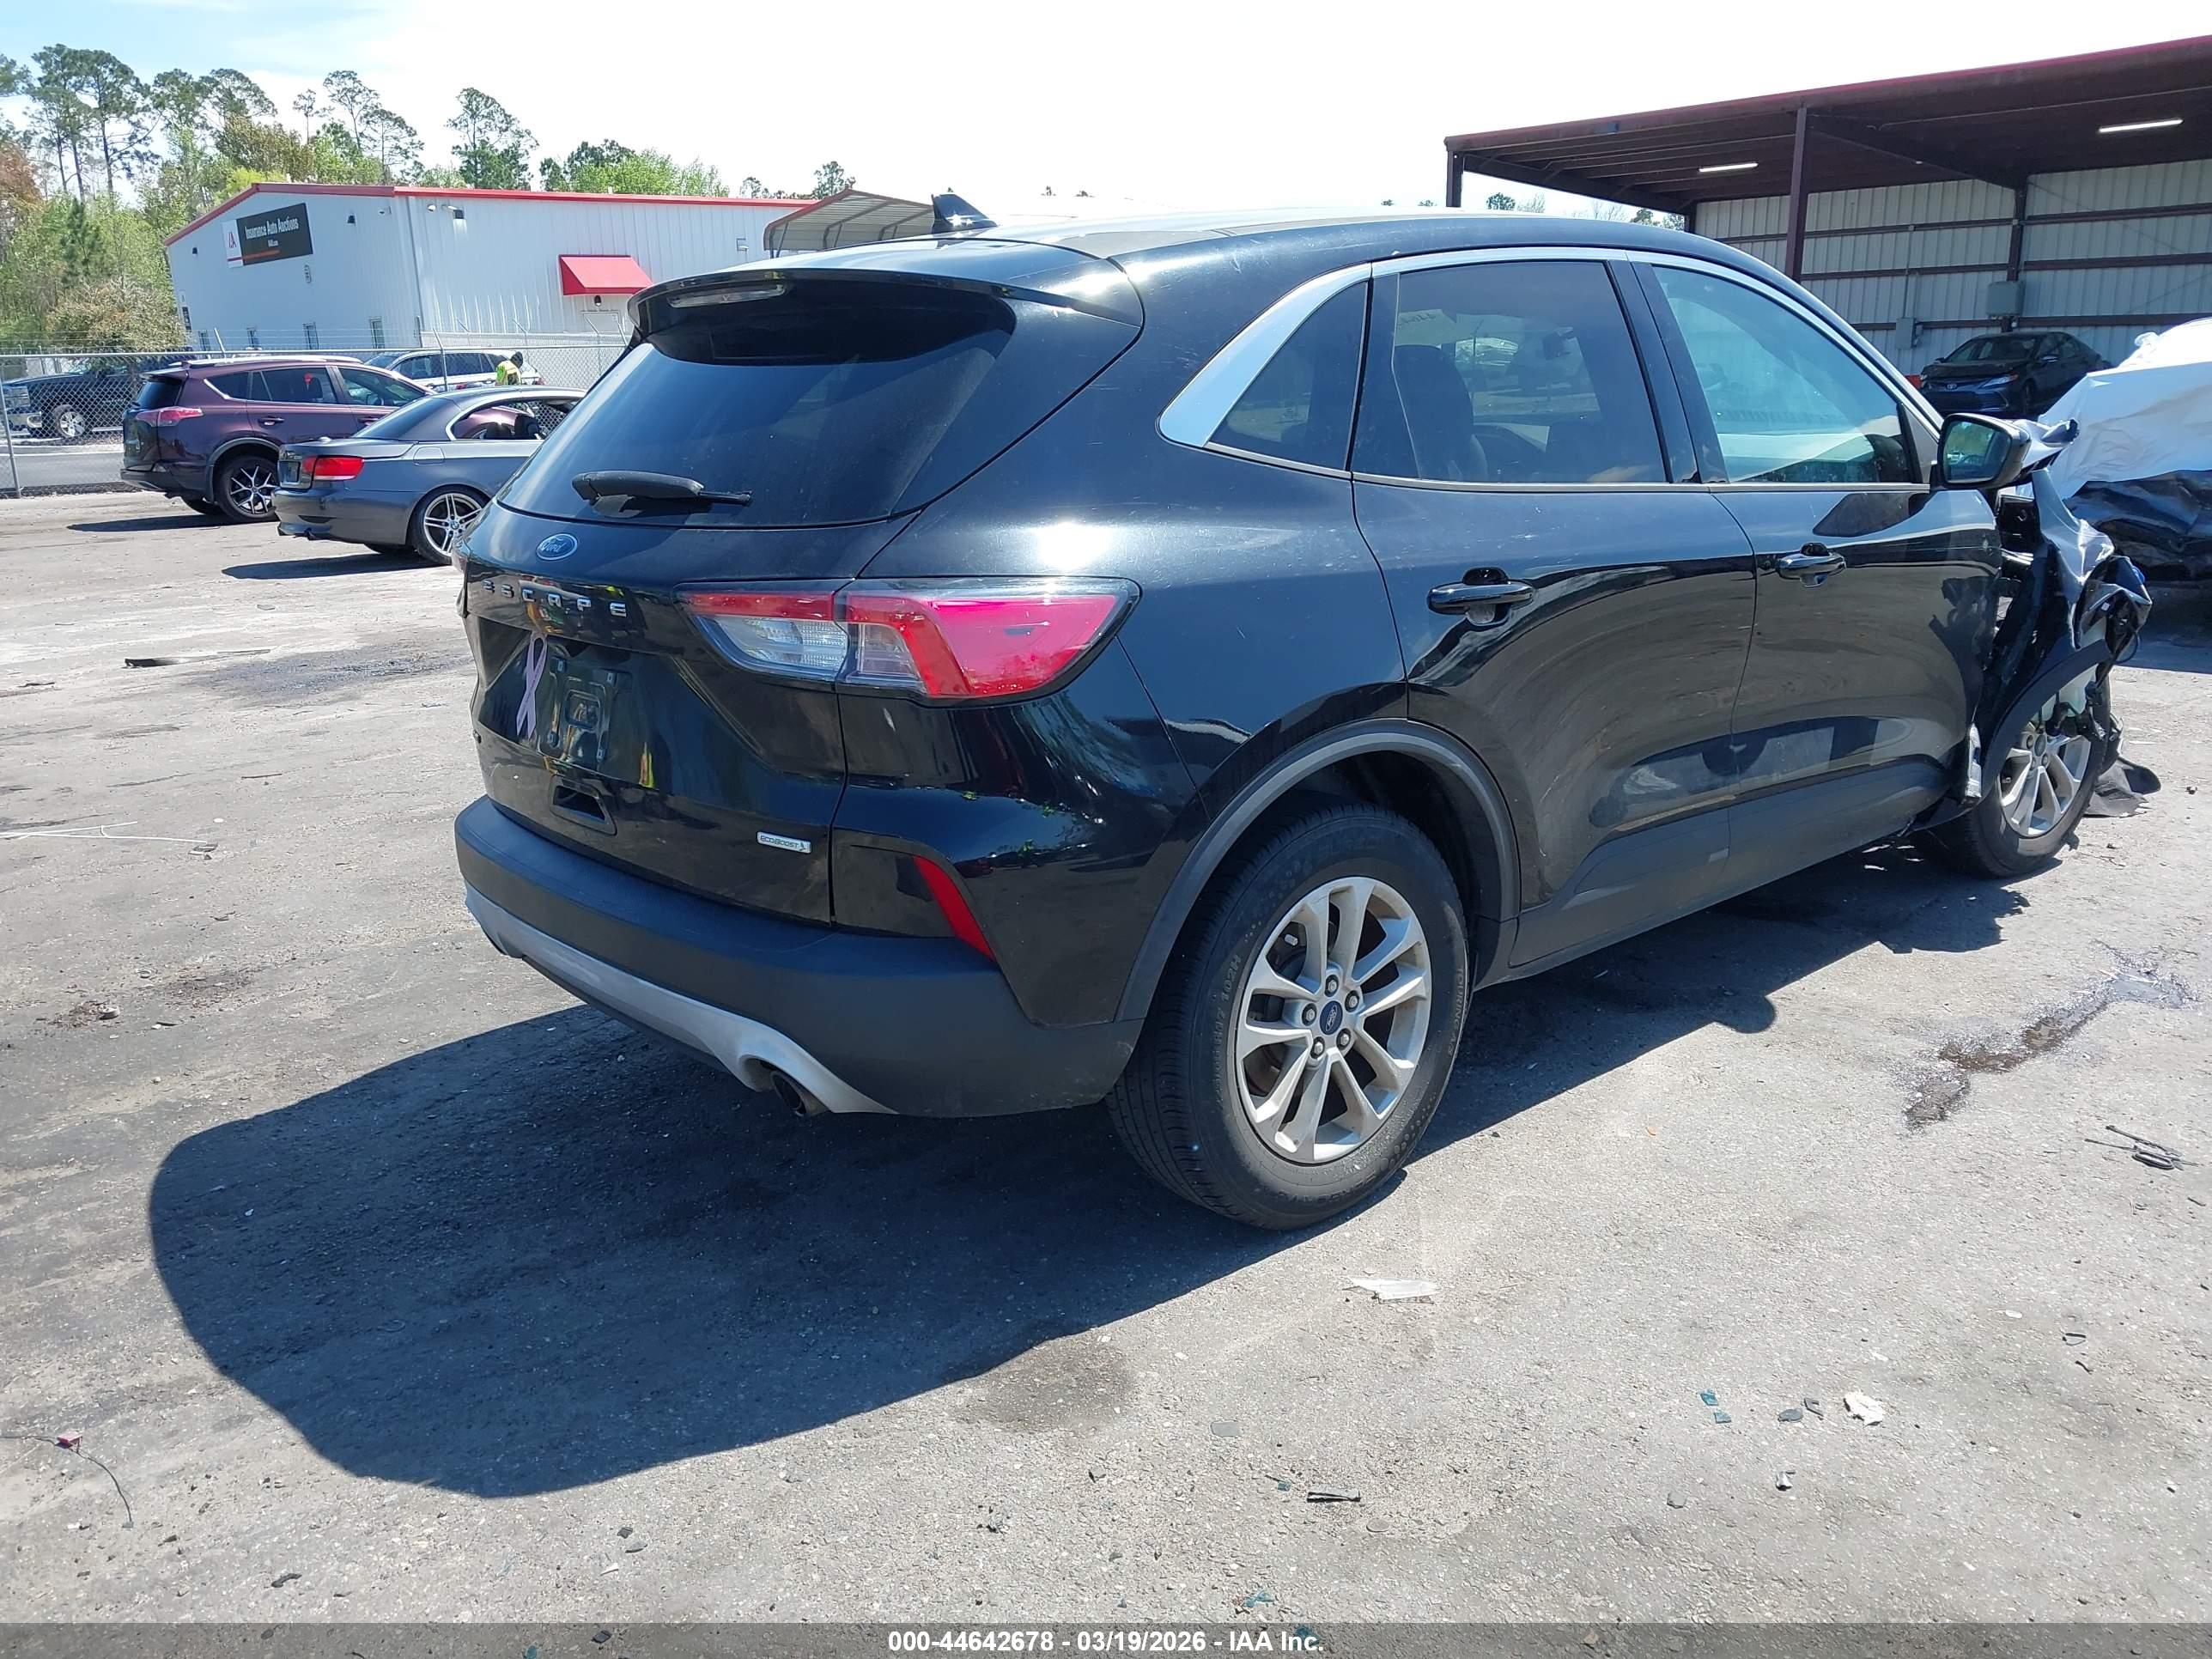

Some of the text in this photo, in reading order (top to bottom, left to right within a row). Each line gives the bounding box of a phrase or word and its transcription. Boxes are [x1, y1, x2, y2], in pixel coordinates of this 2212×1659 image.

[245, 216, 299, 240] Insurance Auto Auctions
[538, 535, 570, 555] Ford
[483, 579, 627, 617] ESCAPE
[1221, 954, 1242, 1002] 102H
[1455, 967, 1465, 1030] TOURING
